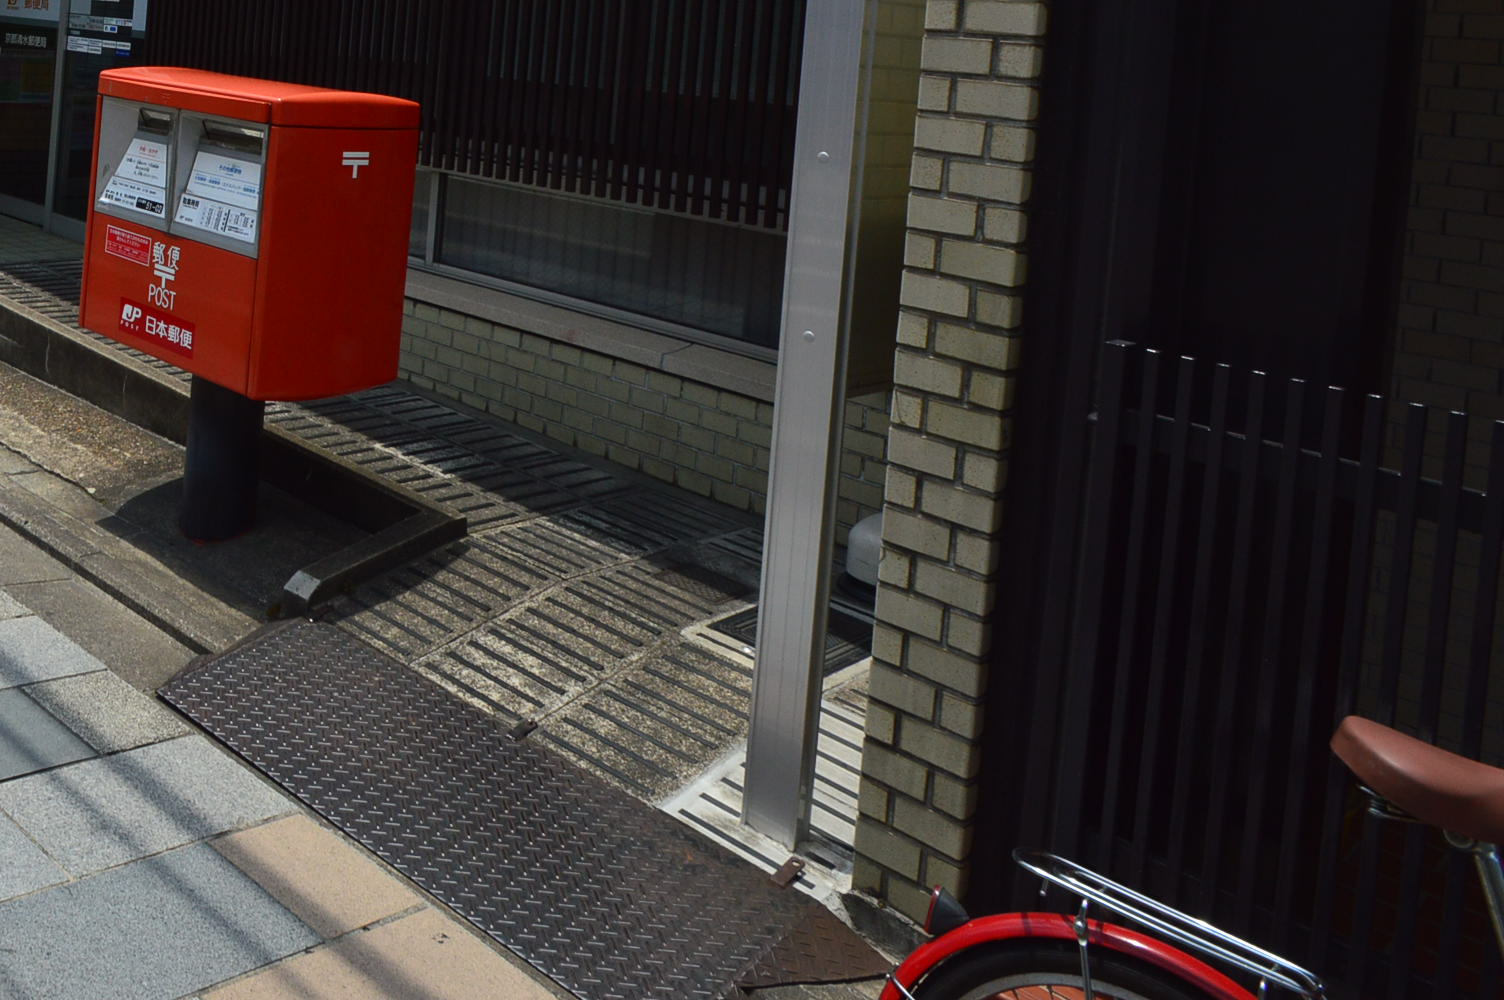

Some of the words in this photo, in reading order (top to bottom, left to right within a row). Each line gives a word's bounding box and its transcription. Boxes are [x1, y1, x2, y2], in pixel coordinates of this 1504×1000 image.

[152, 241, 181, 271] 郵便
[148, 283, 176, 311] POST
[145, 315, 193, 351] 日本郵便
